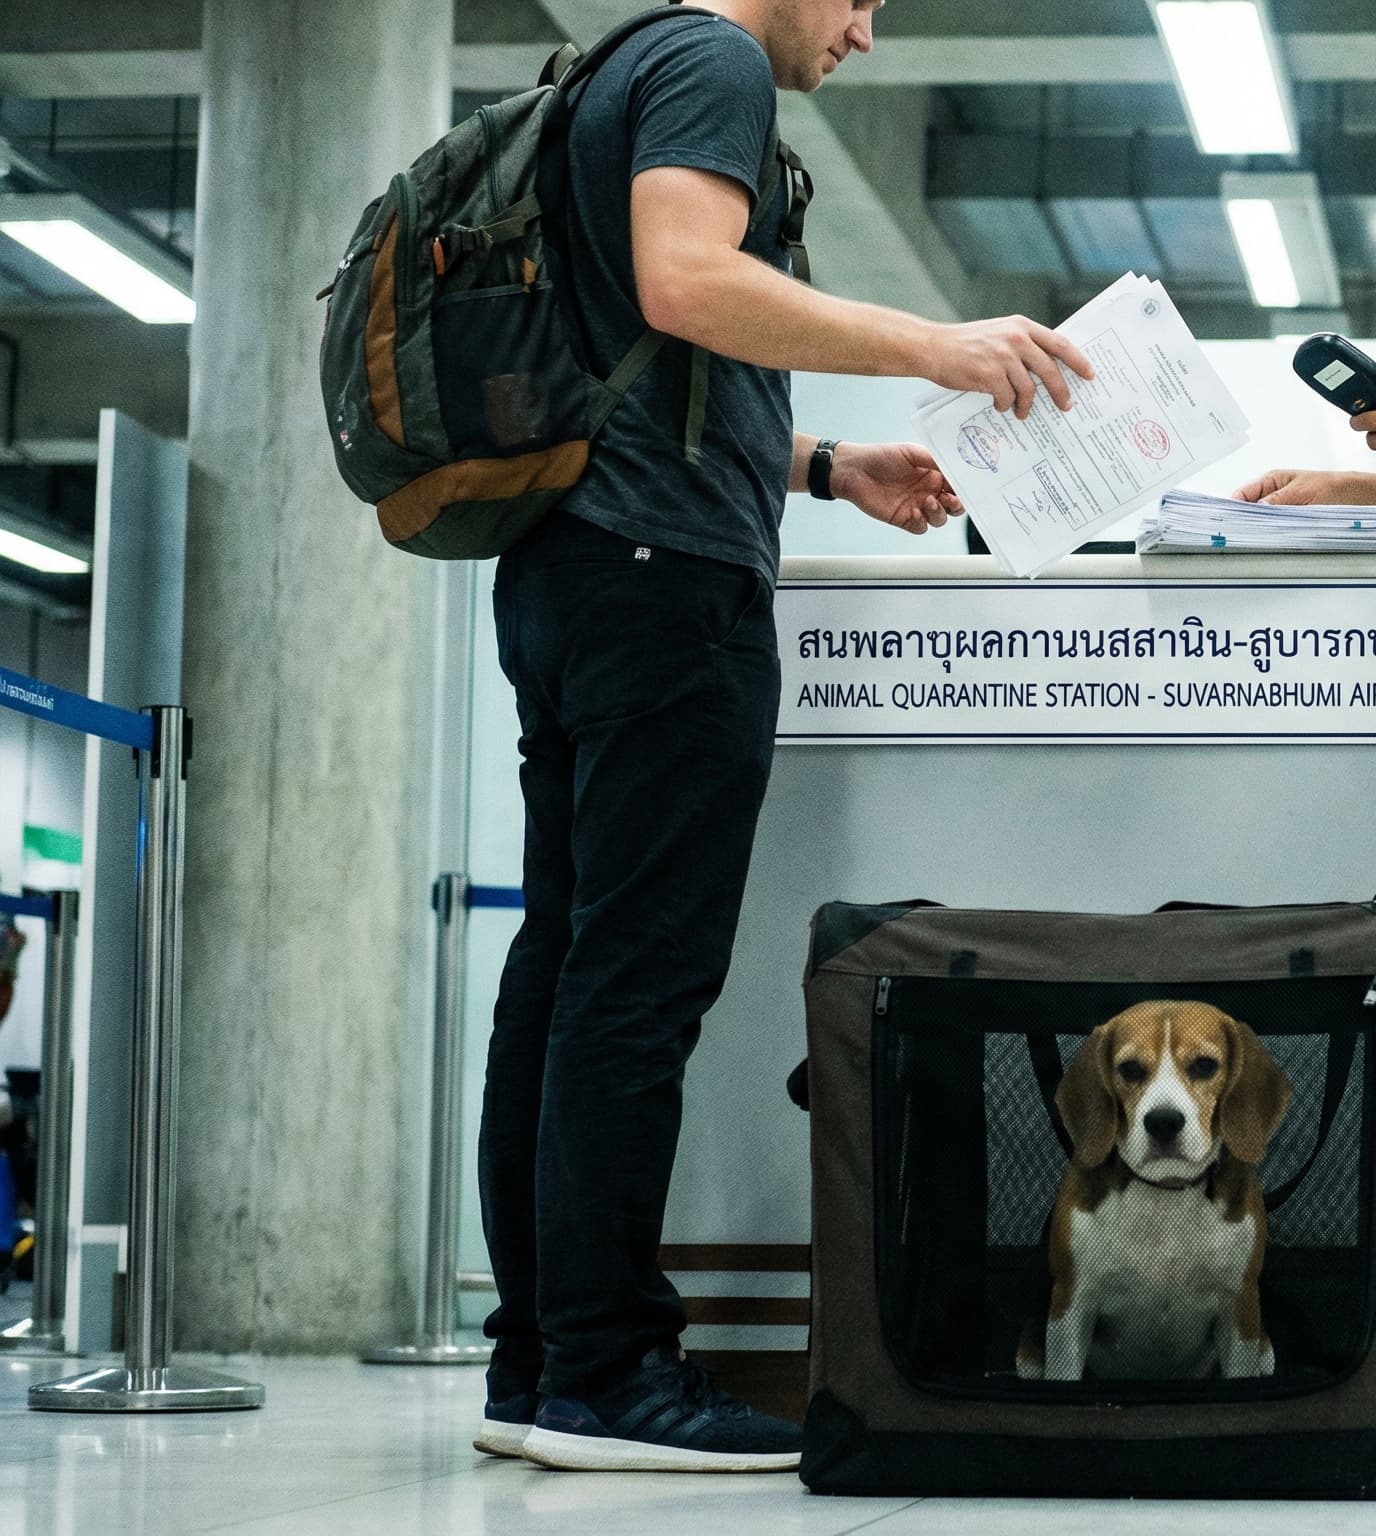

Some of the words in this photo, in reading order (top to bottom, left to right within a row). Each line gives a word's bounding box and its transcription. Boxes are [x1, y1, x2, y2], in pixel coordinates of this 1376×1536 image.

[797, 683, 884, 708] ANIMAL
[891, 683, 1038, 711] QUARANTINE
[1045, 682, 1139, 708] STATION
[1163, 682, 1341, 708] SUVARNABHUMI
